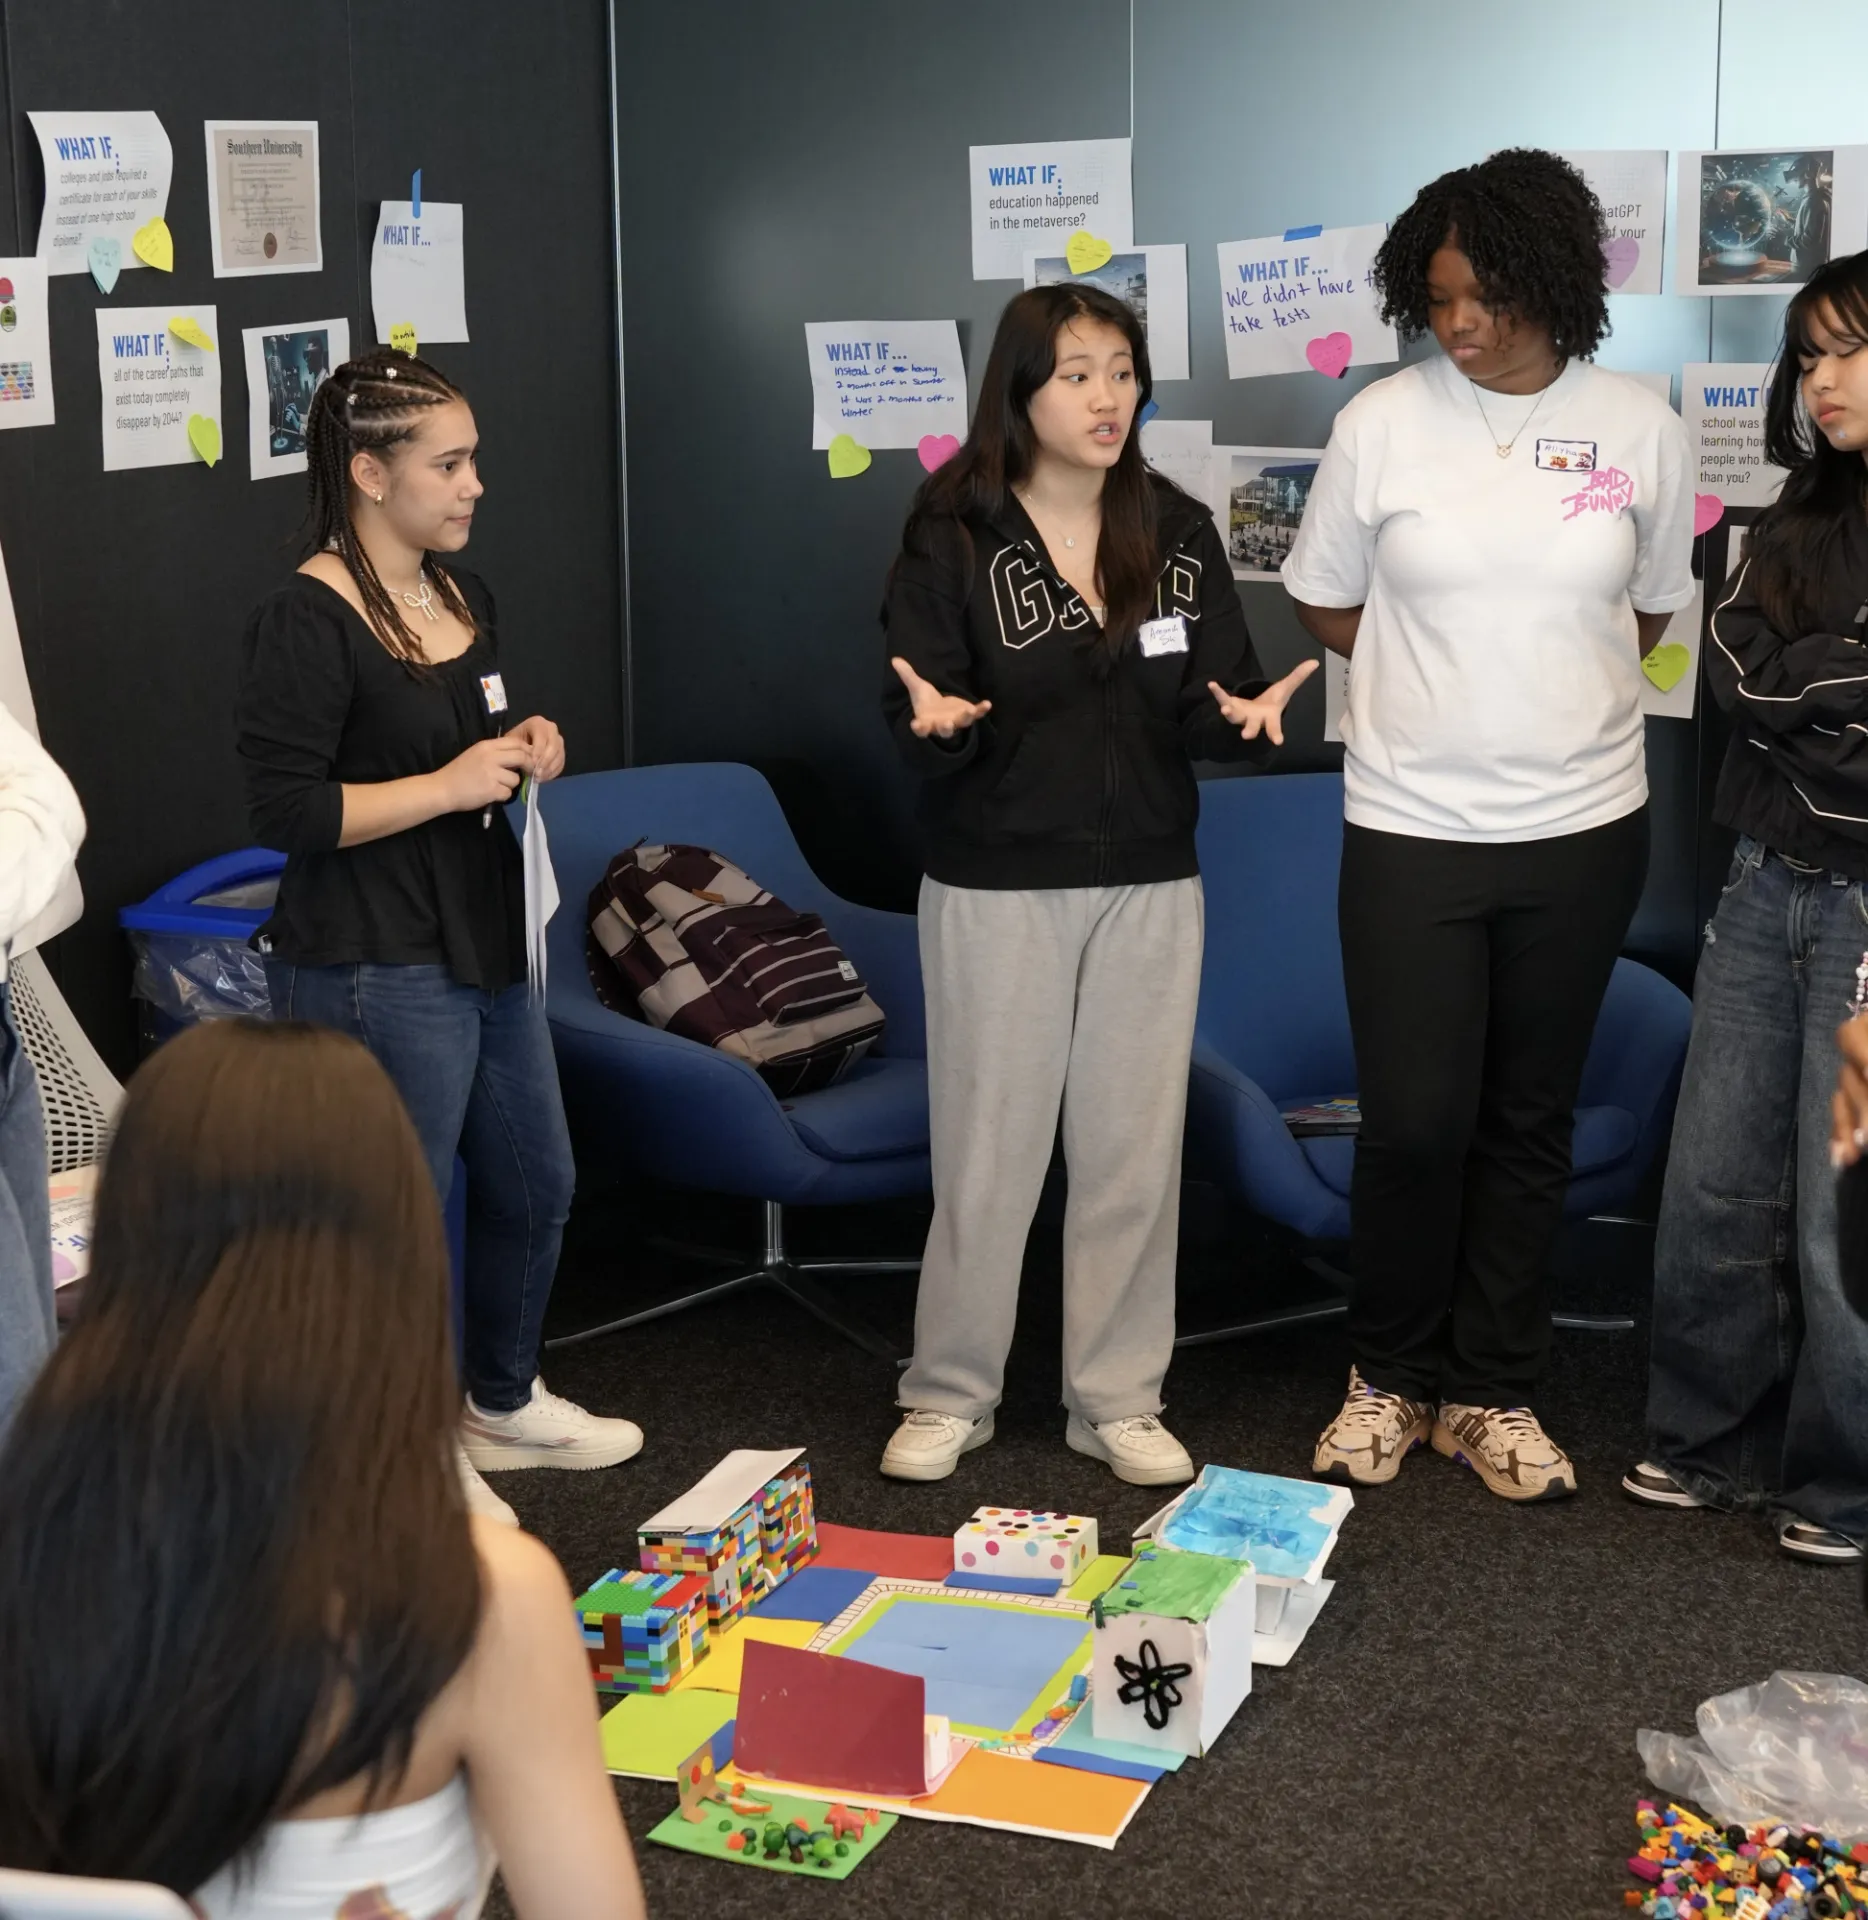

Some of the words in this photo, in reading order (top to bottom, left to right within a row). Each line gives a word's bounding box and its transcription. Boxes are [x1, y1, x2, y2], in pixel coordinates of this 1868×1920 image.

[54, 137, 96, 160] WHAT
[227, 138, 262, 158] Southern
[263, 138, 303, 158] University
[60, 172, 87, 186] colleges
[88, 172, 100, 182] and
[101, 170, 115, 184] jobs
[115, 169, 142, 184] required
[142, 171, 148, 180] a
[989, 165, 1037, 187] WHAT
[59, 192, 92, 206] certificate
[93, 192, 102, 203] for
[103, 190, 118, 202] each
[119, 189, 127, 201] of
[126, 190, 141, 203] your
[141, 188, 158, 200] skills
[989, 194, 1043, 210] education
[1045, 192, 1099, 210] happened
[56, 213, 80, 226] instead
[80, 212, 88, 224] of
[88, 214, 100, 224] one
[100, 211, 115, 225] high
[115, 209, 136, 222] school
[1600, 204, 1642, 218] hatGPT
[990, 216, 1000, 230] in
[1003, 215, 1020, 229] the
[1023, 212, 1086, 229] metaverse?
[53, 232, 82, 247] diploma?
[383, 225, 409, 245] WHAT
[1238, 259, 1289, 283] WHAT
[1226, 286, 1254, 308] We
[1318, 277, 1355, 297] have
[1229, 315, 1264, 334] take
[1273, 308, 1311, 328] tests
[113, 334, 150, 358] WHAT
[826, 342, 871, 361] WHAT
[114, 368, 122, 382] all
[123, 368, 131, 382] of
[132, 368, 144, 381] the
[145, 369, 169, 380] career
[170, 366, 188, 381] paths
[189, 365, 204, 377] that
[874, 364, 887, 374] of
[836, 381, 844, 389] 2
[879, 379, 896, 387] off
[115, 392, 132, 406] exist
[133, 391, 153, 406] today
[154, 388, 190, 404] completely
[926, 394, 945, 402] off
[1703, 387, 1759, 407] WHAT
[116, 416, 152, 431] disappear
[152, 413, 161, 429] by
[162, 411, 183, 426] 2044?
[1701, 416, 1736, 429] school
[1738, 419, 1760, 429] was
[1701, 434, 1744, 450] learning
[1700, 453, 1736, 467] people
[1738, 454, 1760, 465] who
[1581, 466, 1630, 492] BAD
[1700, 471, 1723, 483] than
[1726, 471, 1751, 486] you?
[1561, 481, 1634, 521] BUNNY
